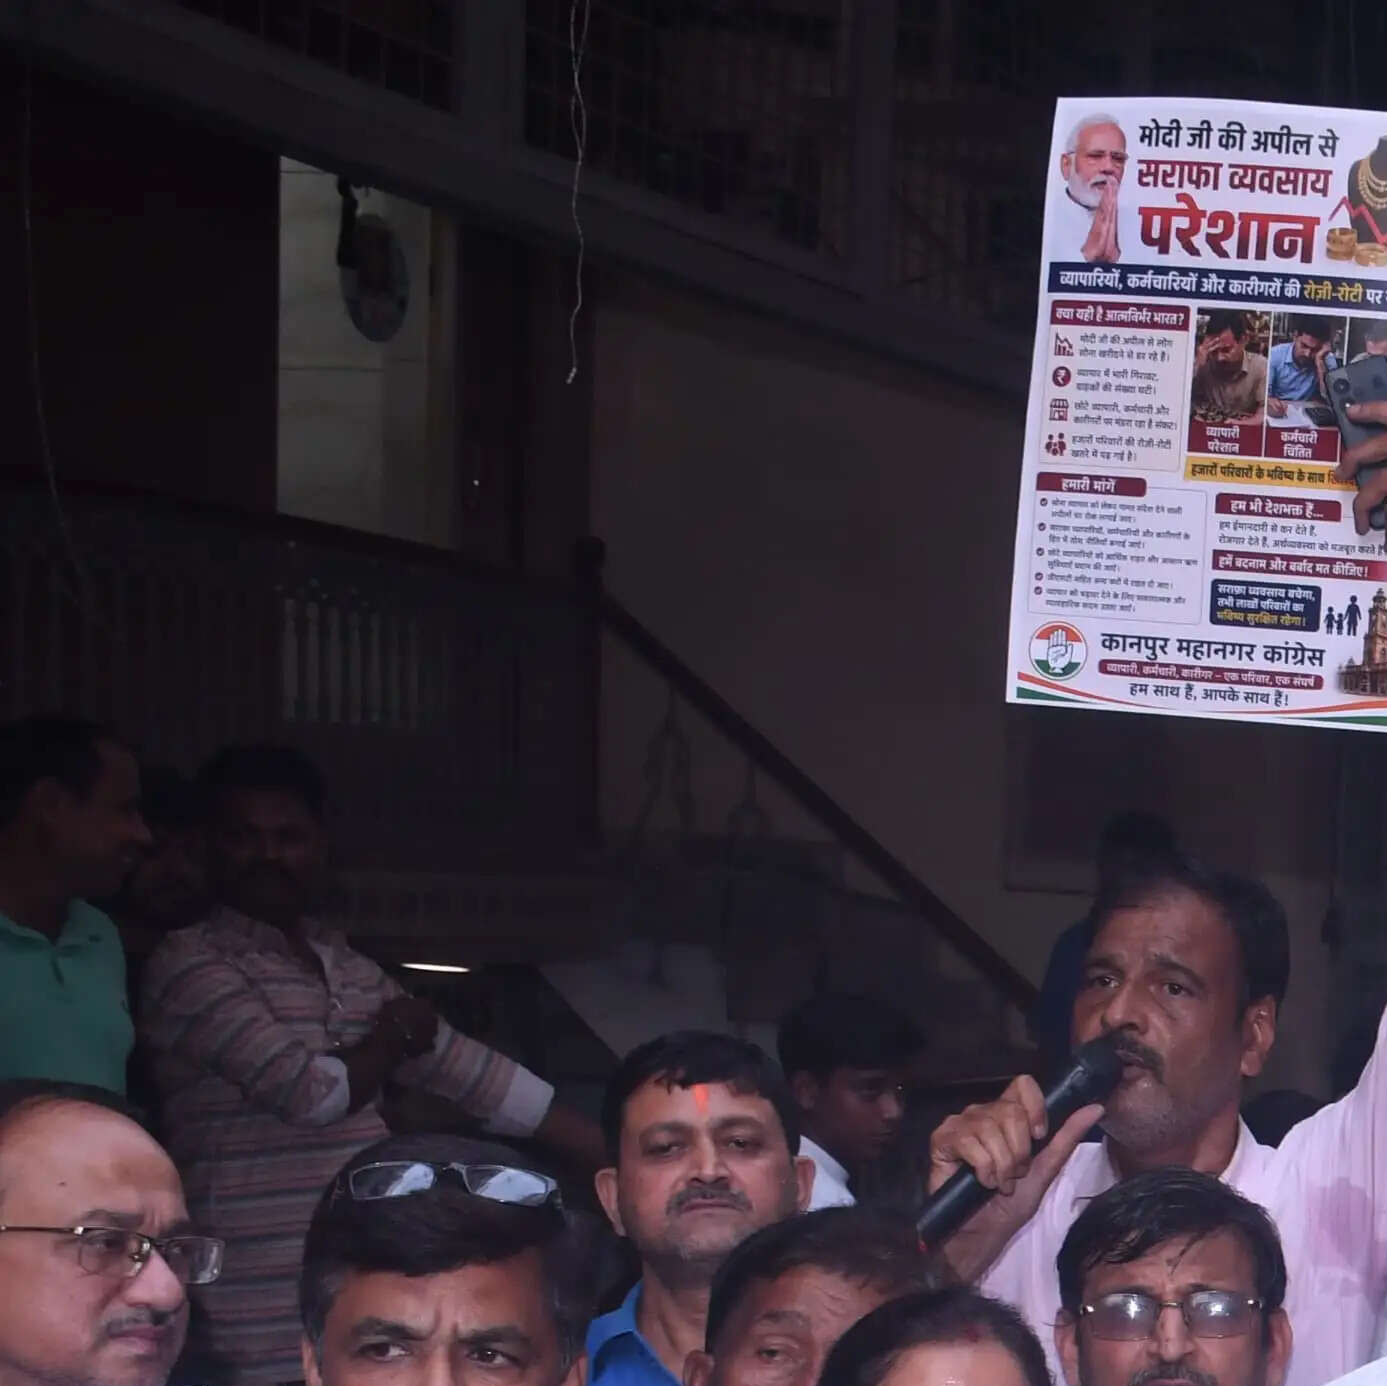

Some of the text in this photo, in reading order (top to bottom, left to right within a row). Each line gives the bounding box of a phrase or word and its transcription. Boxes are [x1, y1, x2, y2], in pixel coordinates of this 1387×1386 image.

[1138, 118, 1340, 158] मोदी जी की अपील से
[1136, 159, 1334, 198] सराफा व्यवसाय
[1137, 192, 1321, 264] परेशान
